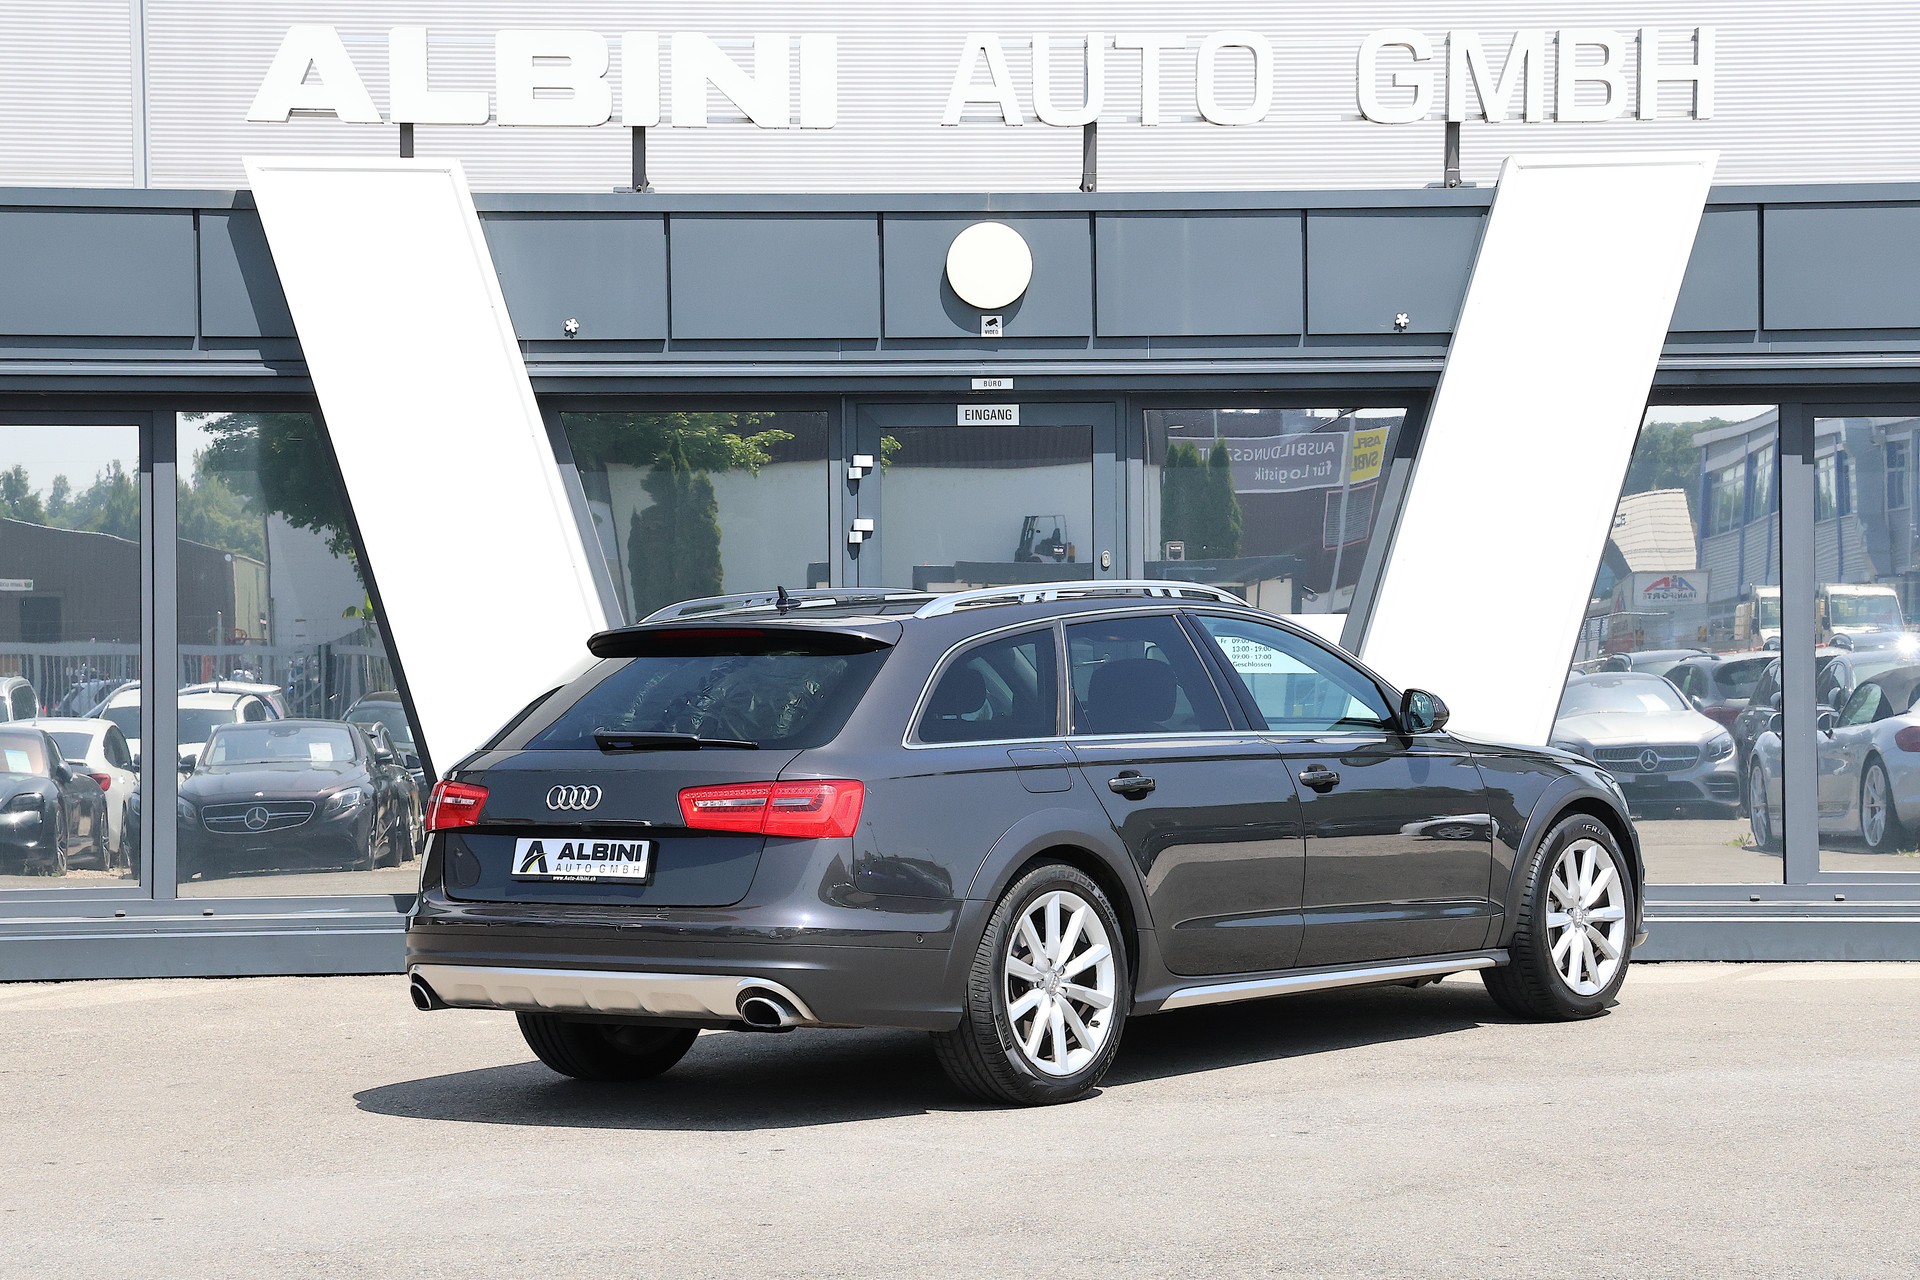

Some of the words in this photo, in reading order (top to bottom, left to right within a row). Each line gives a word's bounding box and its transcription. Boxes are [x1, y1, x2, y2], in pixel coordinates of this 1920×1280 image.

[245, 24, 838, 129] ALBINI
[941, 29, 1275, 128] AUTO
[1356, 27, 1717, 125] GMBH
[964, 409, 1012, 420] EINGANG
[557, 843, 643, 862] ALBINI
[555, 863, 593, 873] AUTO
[599, 864, 641, 874] GMBH
